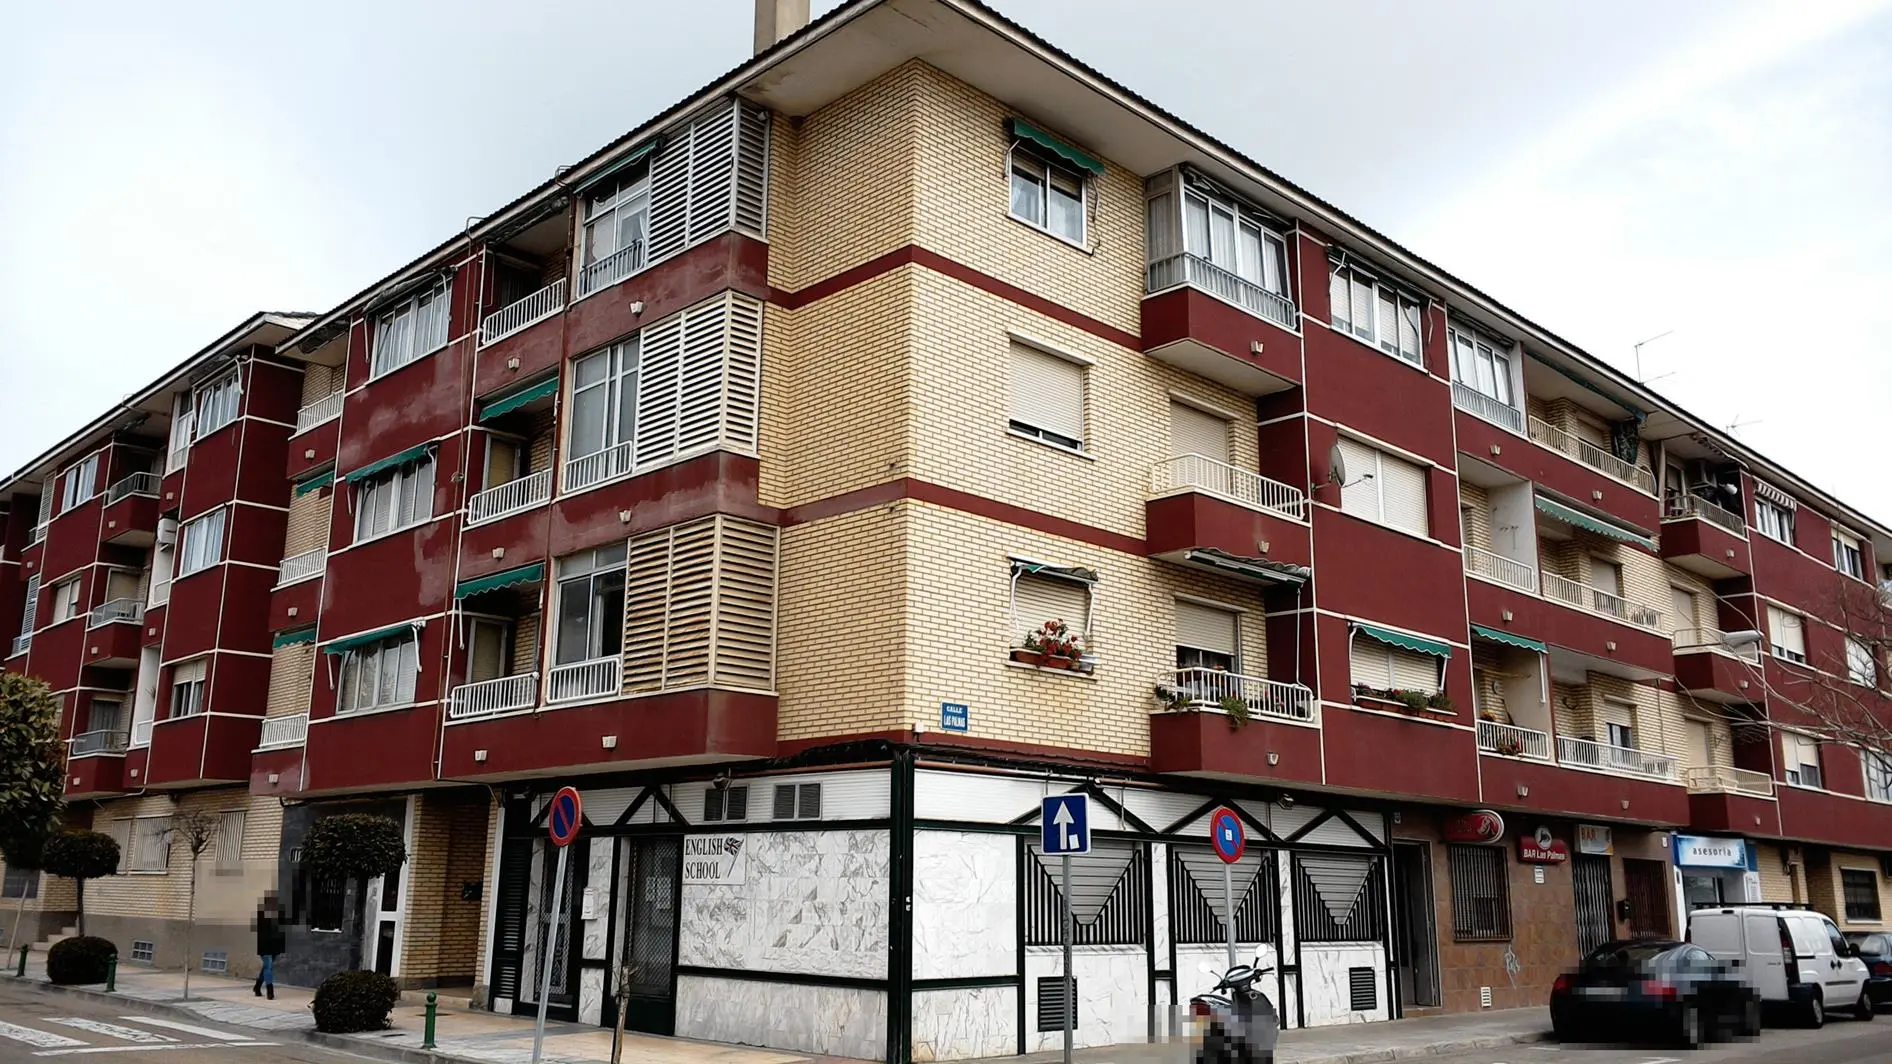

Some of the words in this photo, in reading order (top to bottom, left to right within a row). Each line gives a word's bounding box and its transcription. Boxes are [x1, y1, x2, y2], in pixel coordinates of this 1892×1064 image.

[946, 706, 962, 714] CALLE
[685, 838, 723, 856] ENGLISH
[1523, 848, 1536, 858] BAR
[1536, 850, 1546, 860] Las
[1547, 850, 1565, 861] Palmas
[685, 862, 721, 879] SCHOOL
